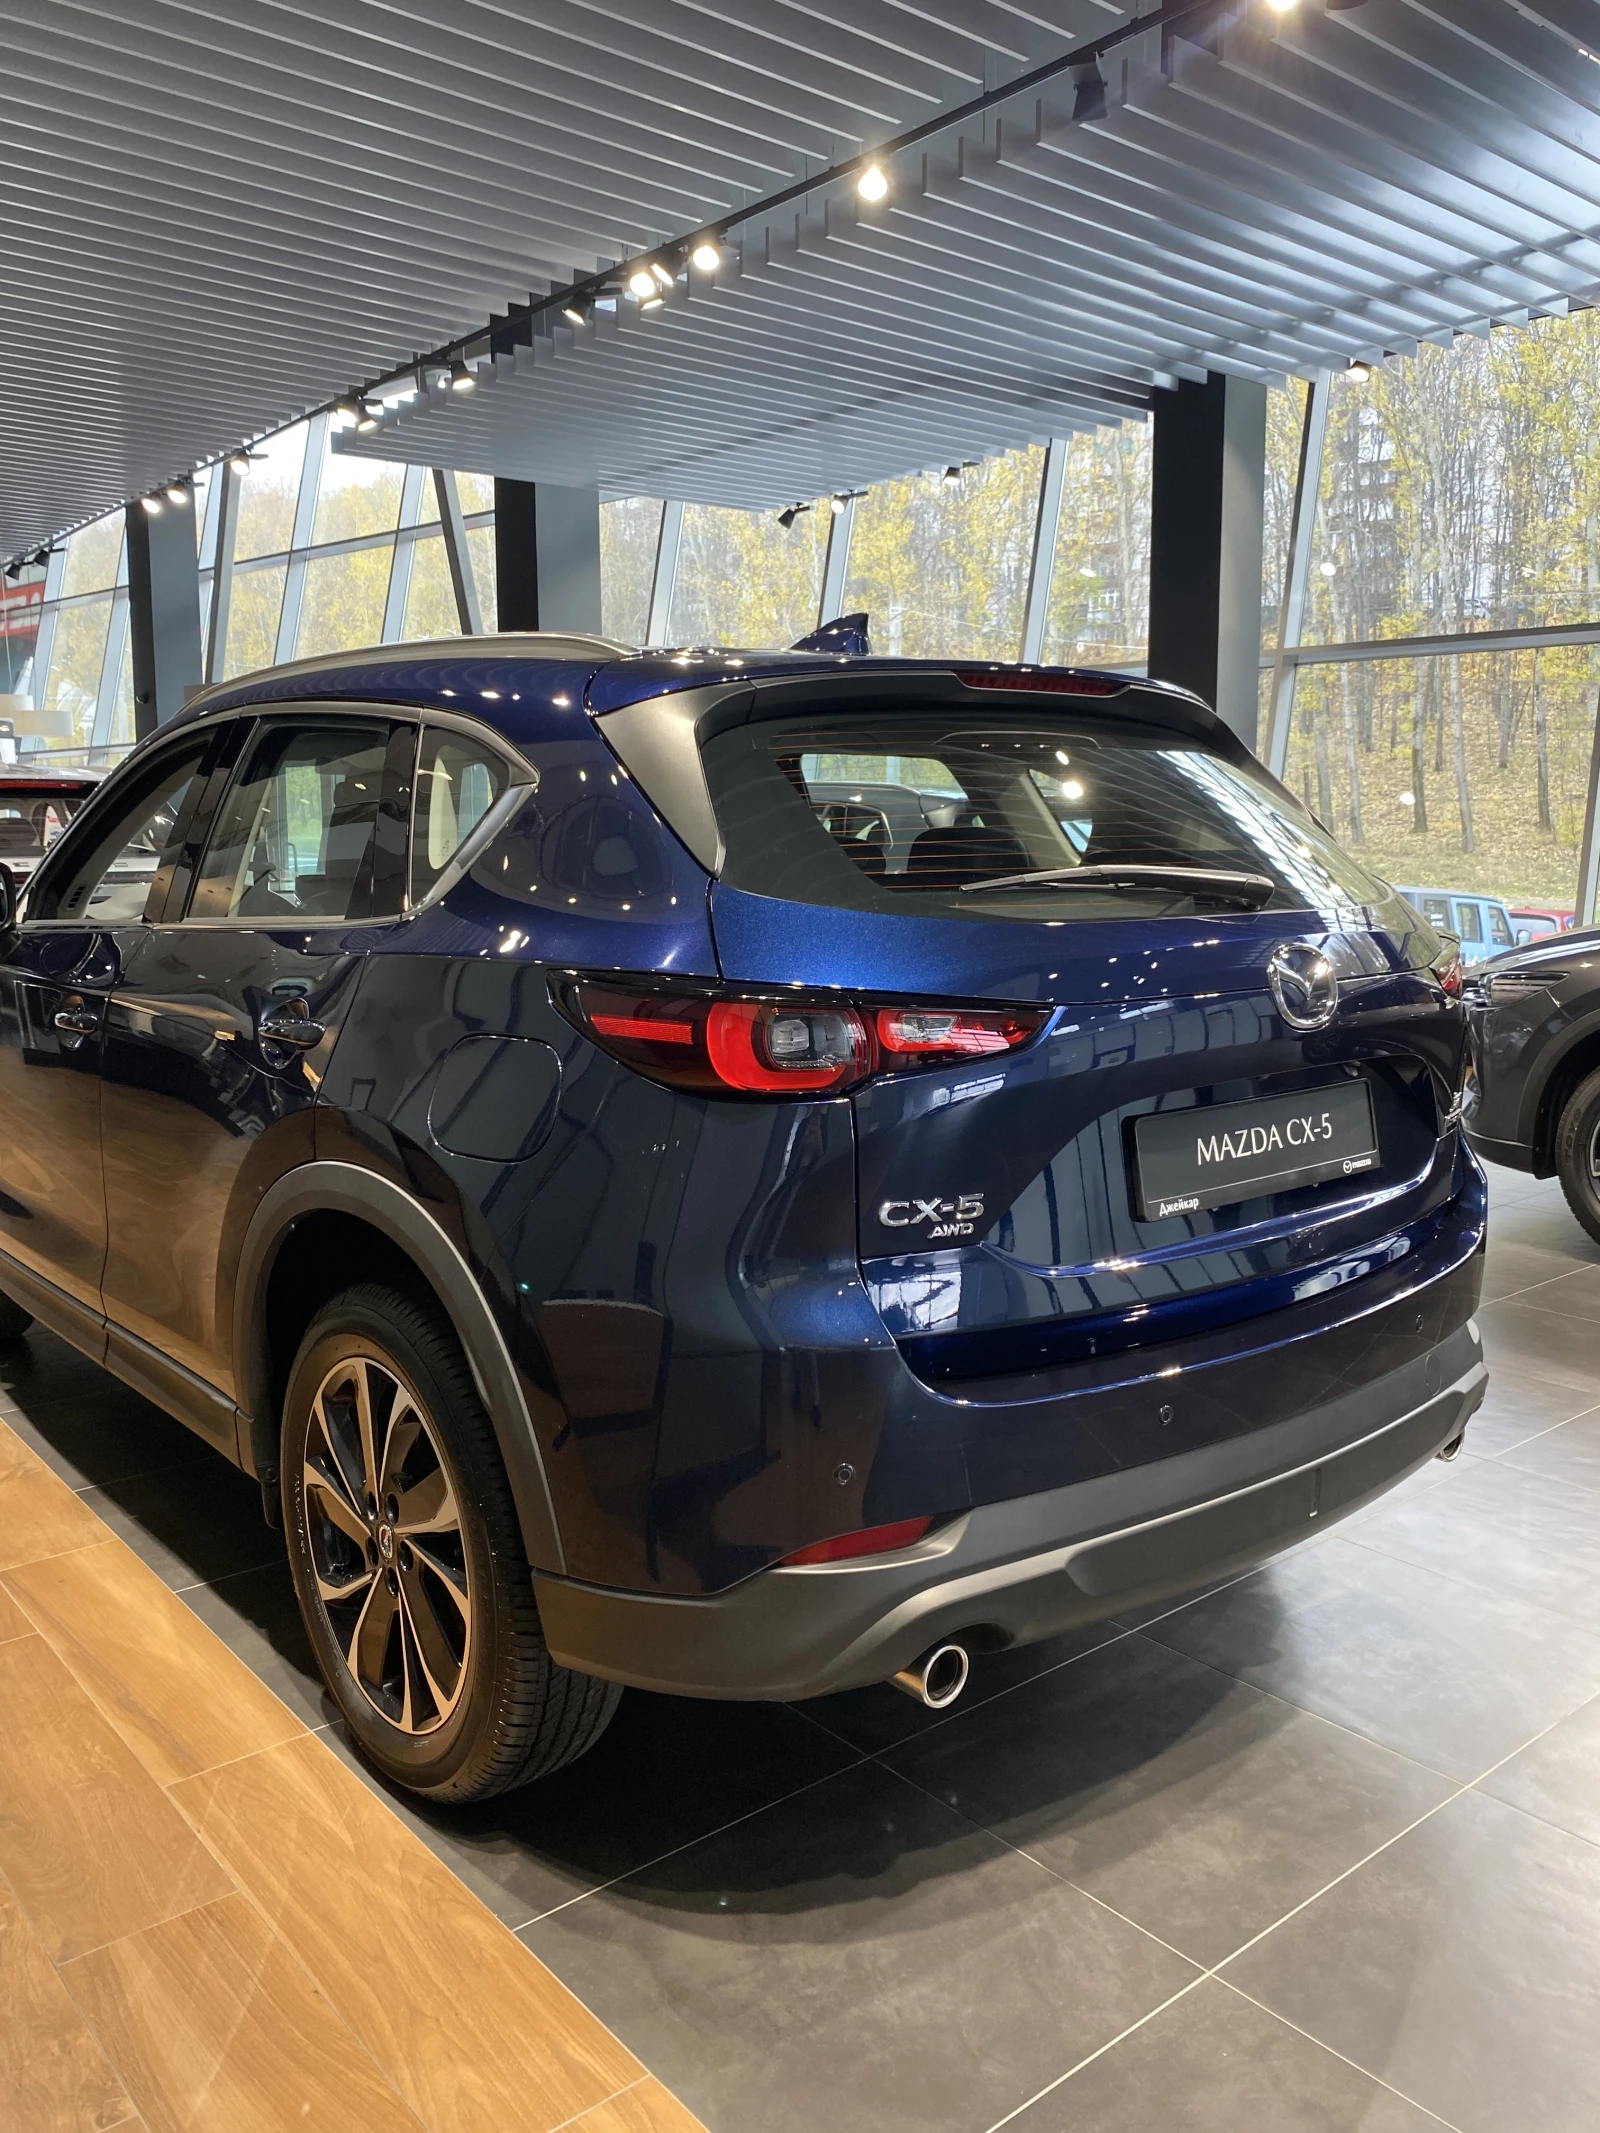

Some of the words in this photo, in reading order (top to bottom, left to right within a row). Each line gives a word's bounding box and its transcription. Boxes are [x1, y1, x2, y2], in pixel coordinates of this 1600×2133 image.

[1197, 1124, 1283, 1165] MAZDA
[1287, 1113, 1332, 1145] CX-5
[879, 1193, 985, 1227] CX-5
[1159, 1198, 1199, 1216] Джейкар
[926, 1223, 974, 1239] AWD
